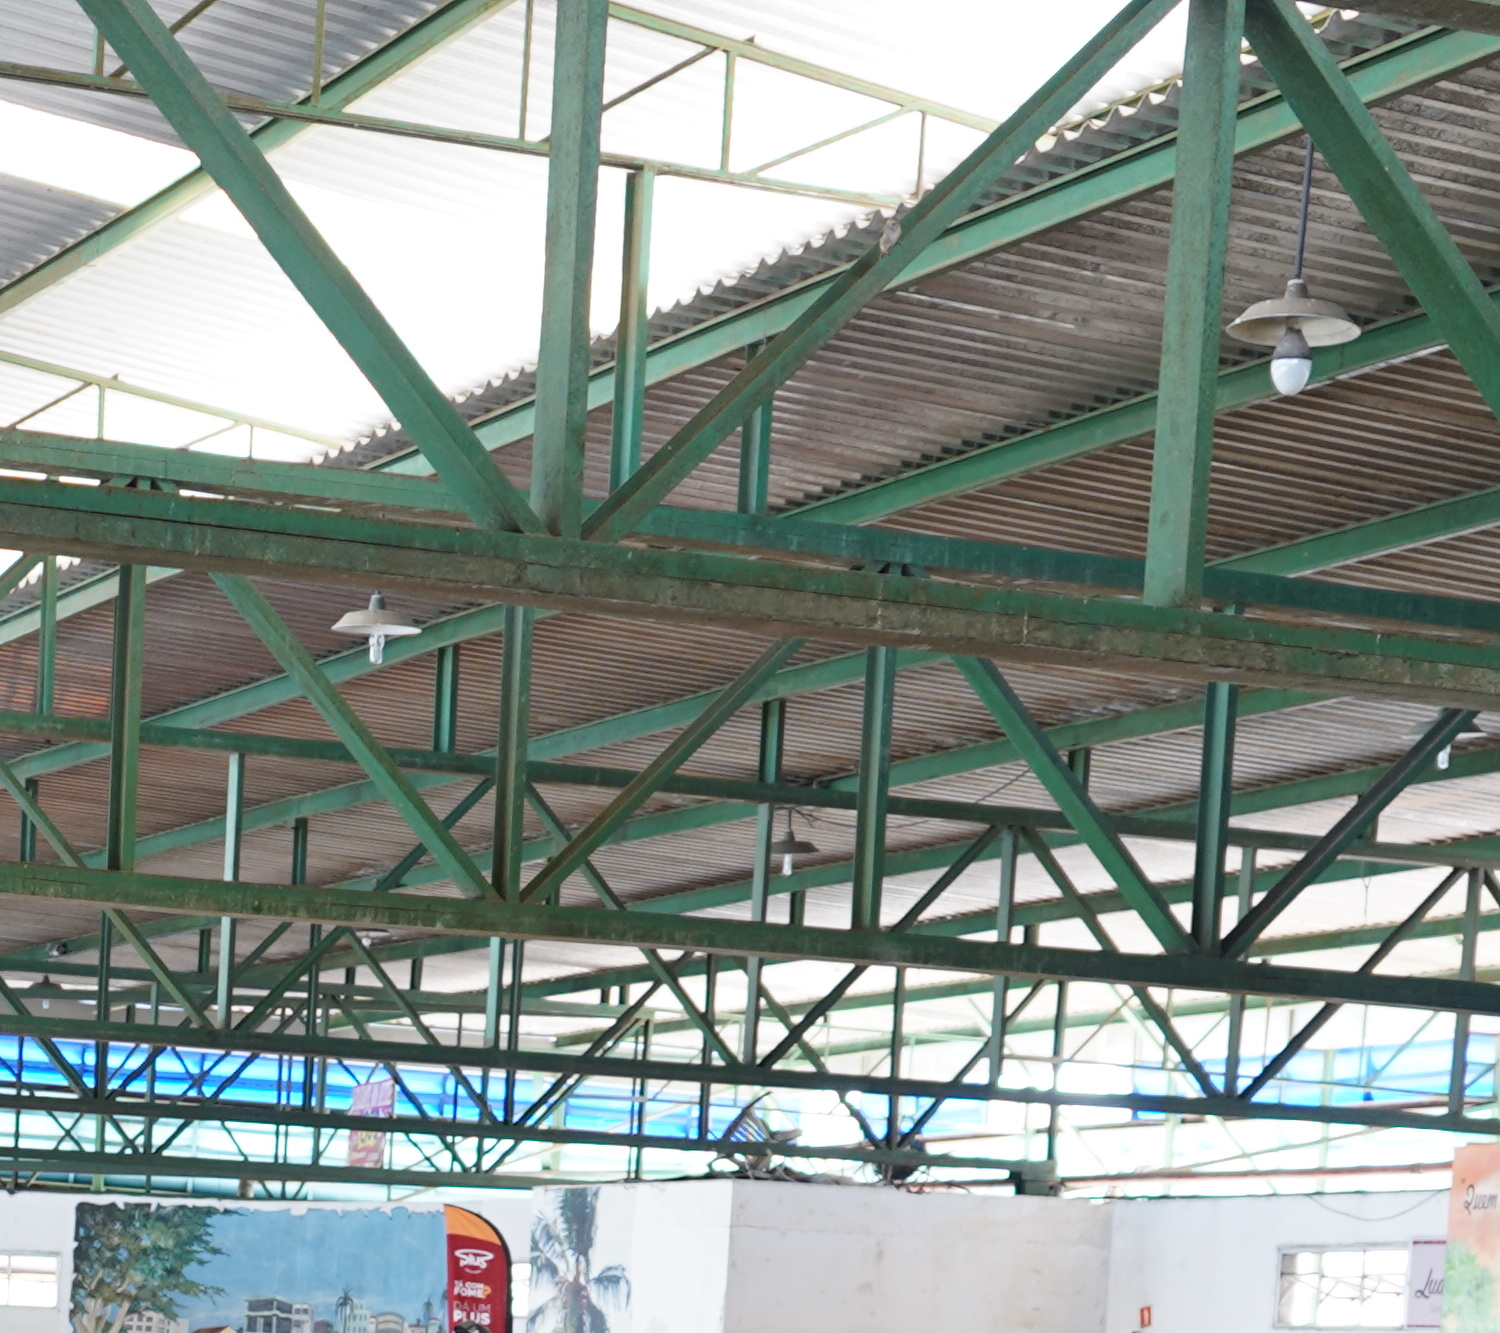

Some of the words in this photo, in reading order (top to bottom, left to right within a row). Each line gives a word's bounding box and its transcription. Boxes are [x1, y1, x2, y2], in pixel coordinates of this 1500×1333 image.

[453, 1285, 492, 1299] FOME?
[453, 1300, 470, 1312] DÁ
[473, 1302, 492, 1313] UM
[453, 1312, 491, 1326] PLUS
